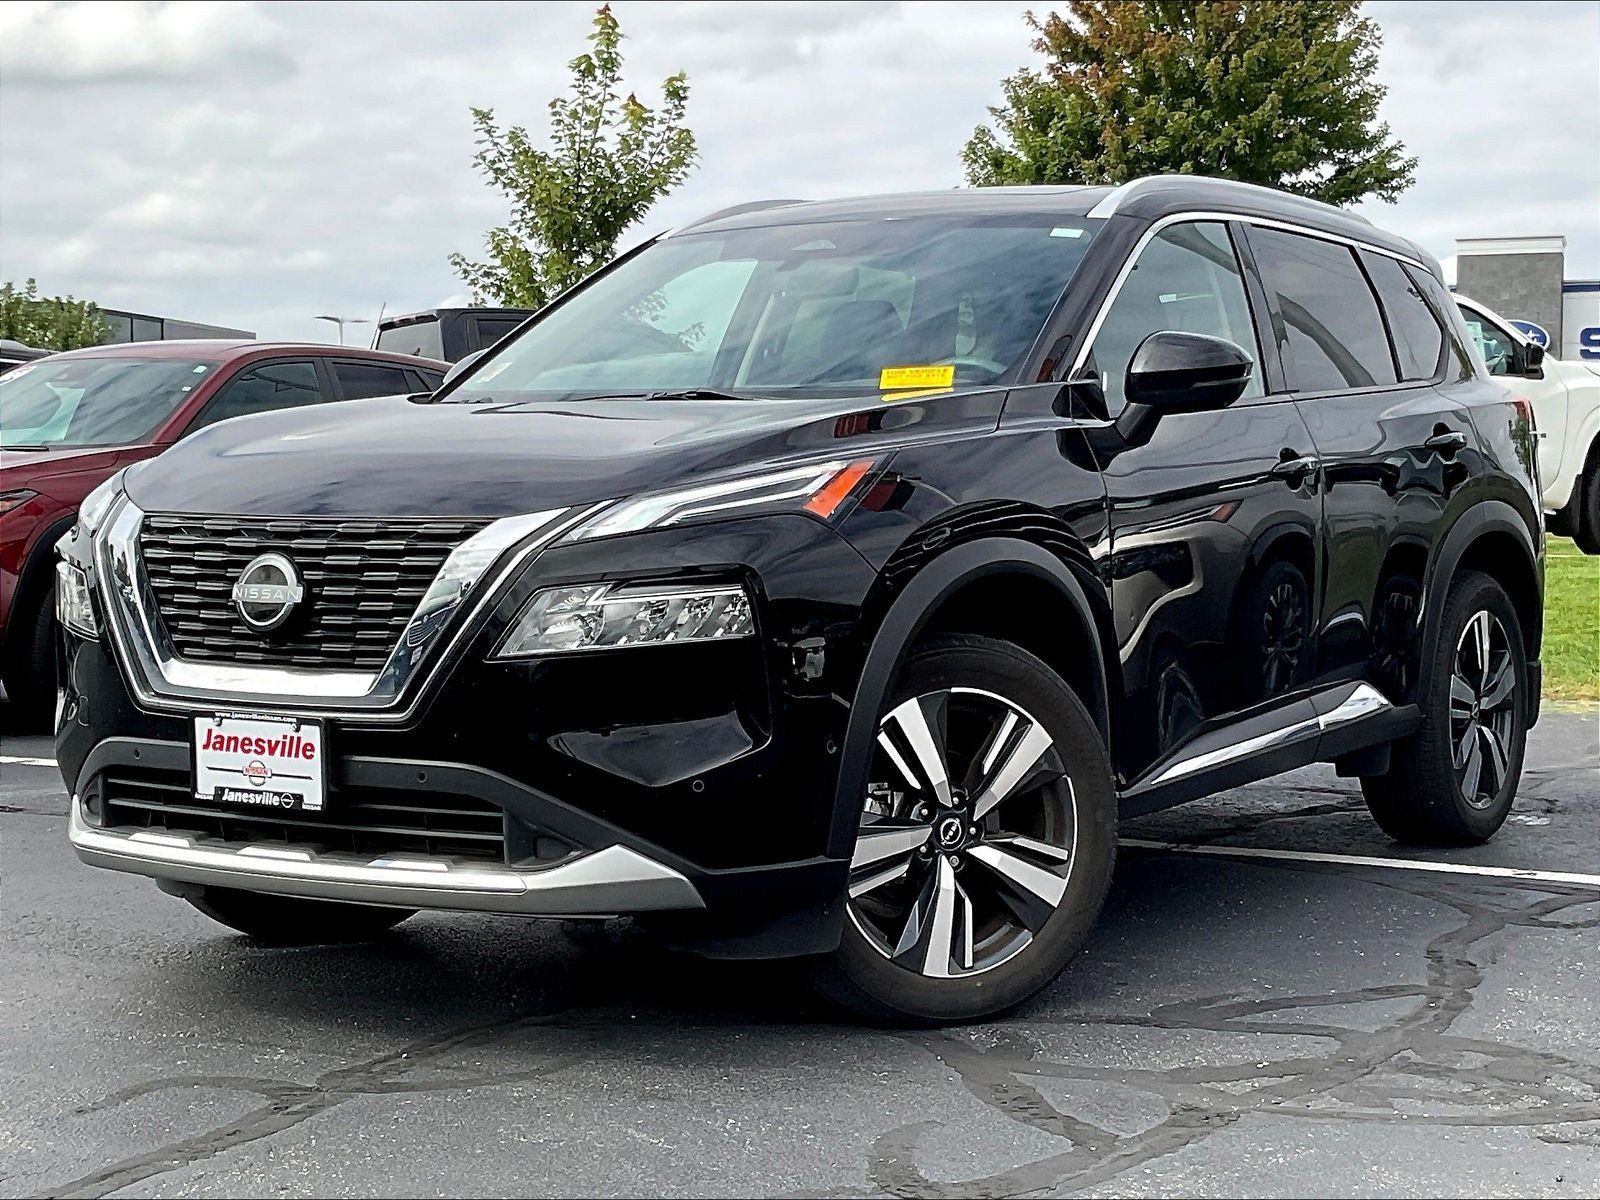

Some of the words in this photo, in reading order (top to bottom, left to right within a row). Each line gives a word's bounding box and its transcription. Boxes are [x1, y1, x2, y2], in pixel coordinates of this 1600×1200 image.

[234, 586, 300, 600] NISSAN
[202, 728, 316, 760] Janesville
[222, 789, 280, 806] Janesville
